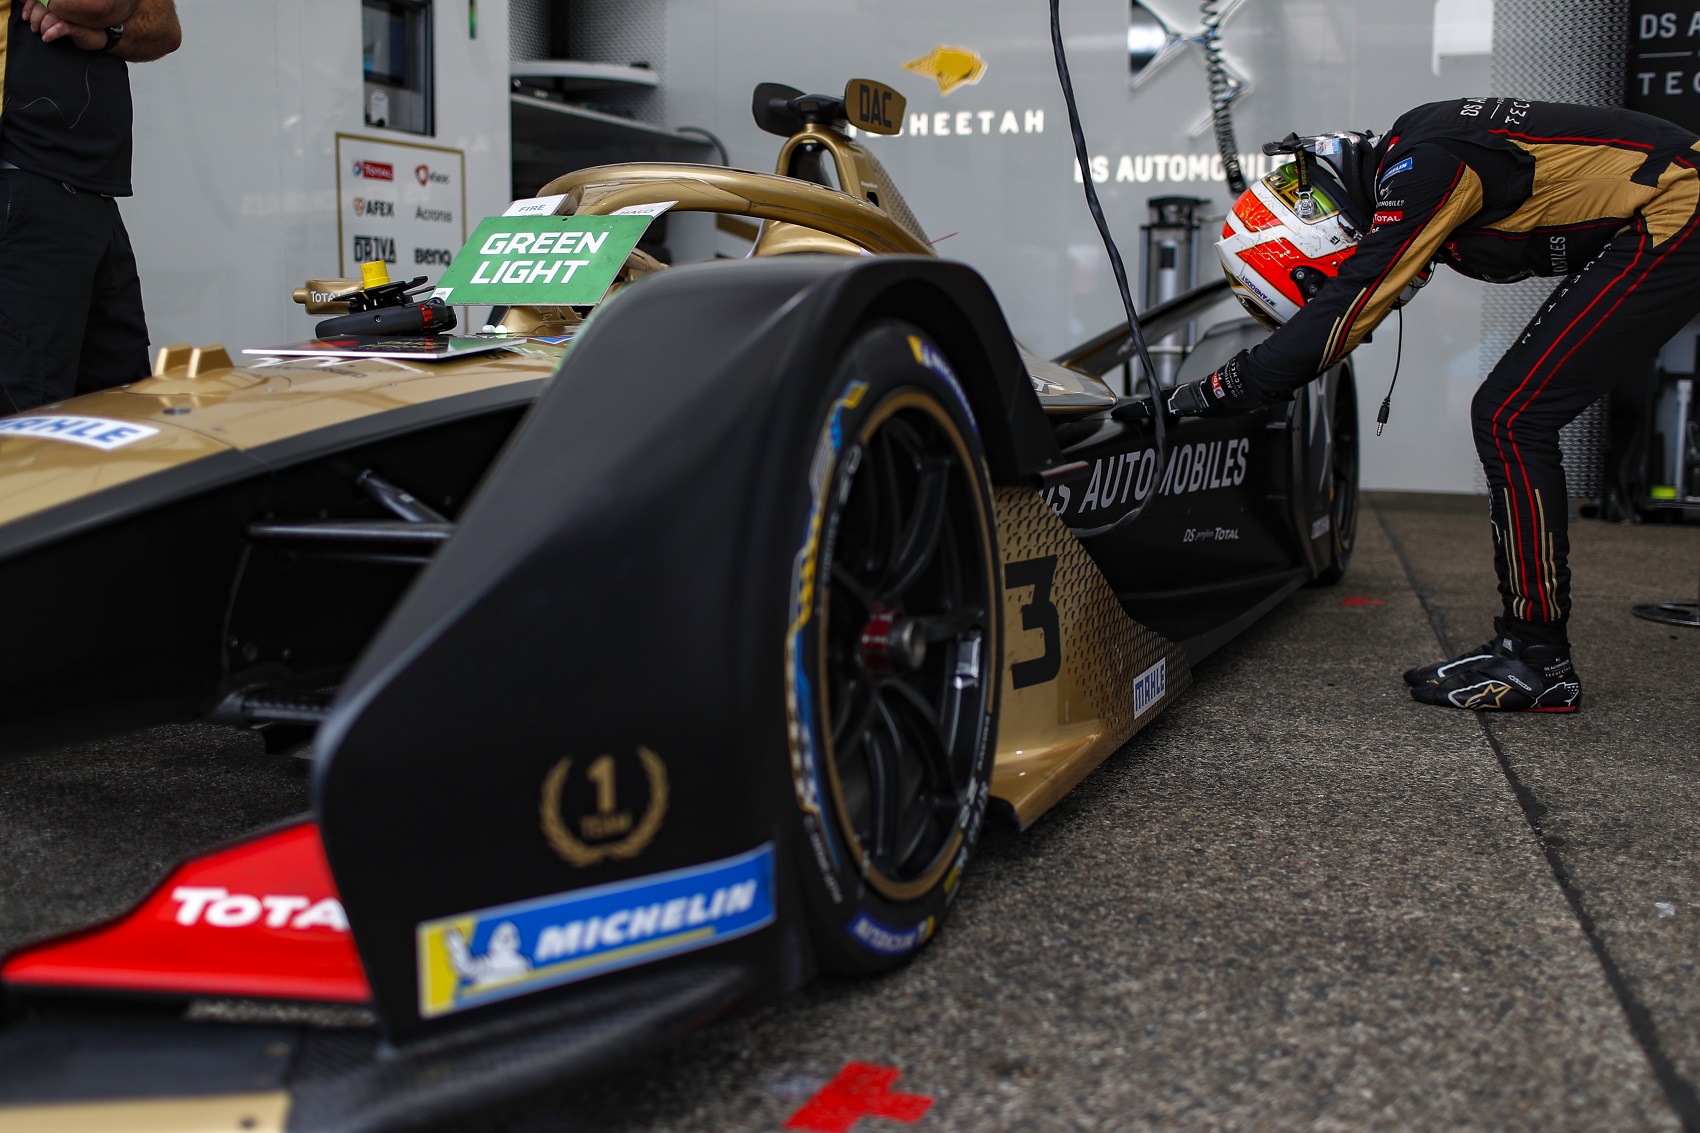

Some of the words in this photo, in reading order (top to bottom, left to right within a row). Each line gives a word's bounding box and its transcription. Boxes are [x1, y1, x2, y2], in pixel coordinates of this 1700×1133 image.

[1640, 12, 1678, 39] DS
[859, 84, 893, 128] DAC
[1116, 153, 1297, 183] AUTOMOILE
[366, 200, 395, 218] AFEX
[415, 206, 452, 223] Acronis
[518, 204, 546, 213] FIRE
[1374, 213, 1401, 222] TOTAL
[479, 231, 610, 255] GREEN
[469, 260, 590, 284] LIGHT
[311, 291, 341, 303] TOTA
[1241, 274, 1272, 304] FANBOOST
[0, 417, 141, 444] AHLE
[1183, 528, 1196, 542] DS
[1214, 527, 1239, 540] TOTAL
[1004, 555, 1061, 690] 3
[1135, 663, 1164, 712] MAHLE
[587, 755, 615, 812] 1
[172, 886, 350, 931] TOTA
[534, 878, 757, 962] MICHELIN
